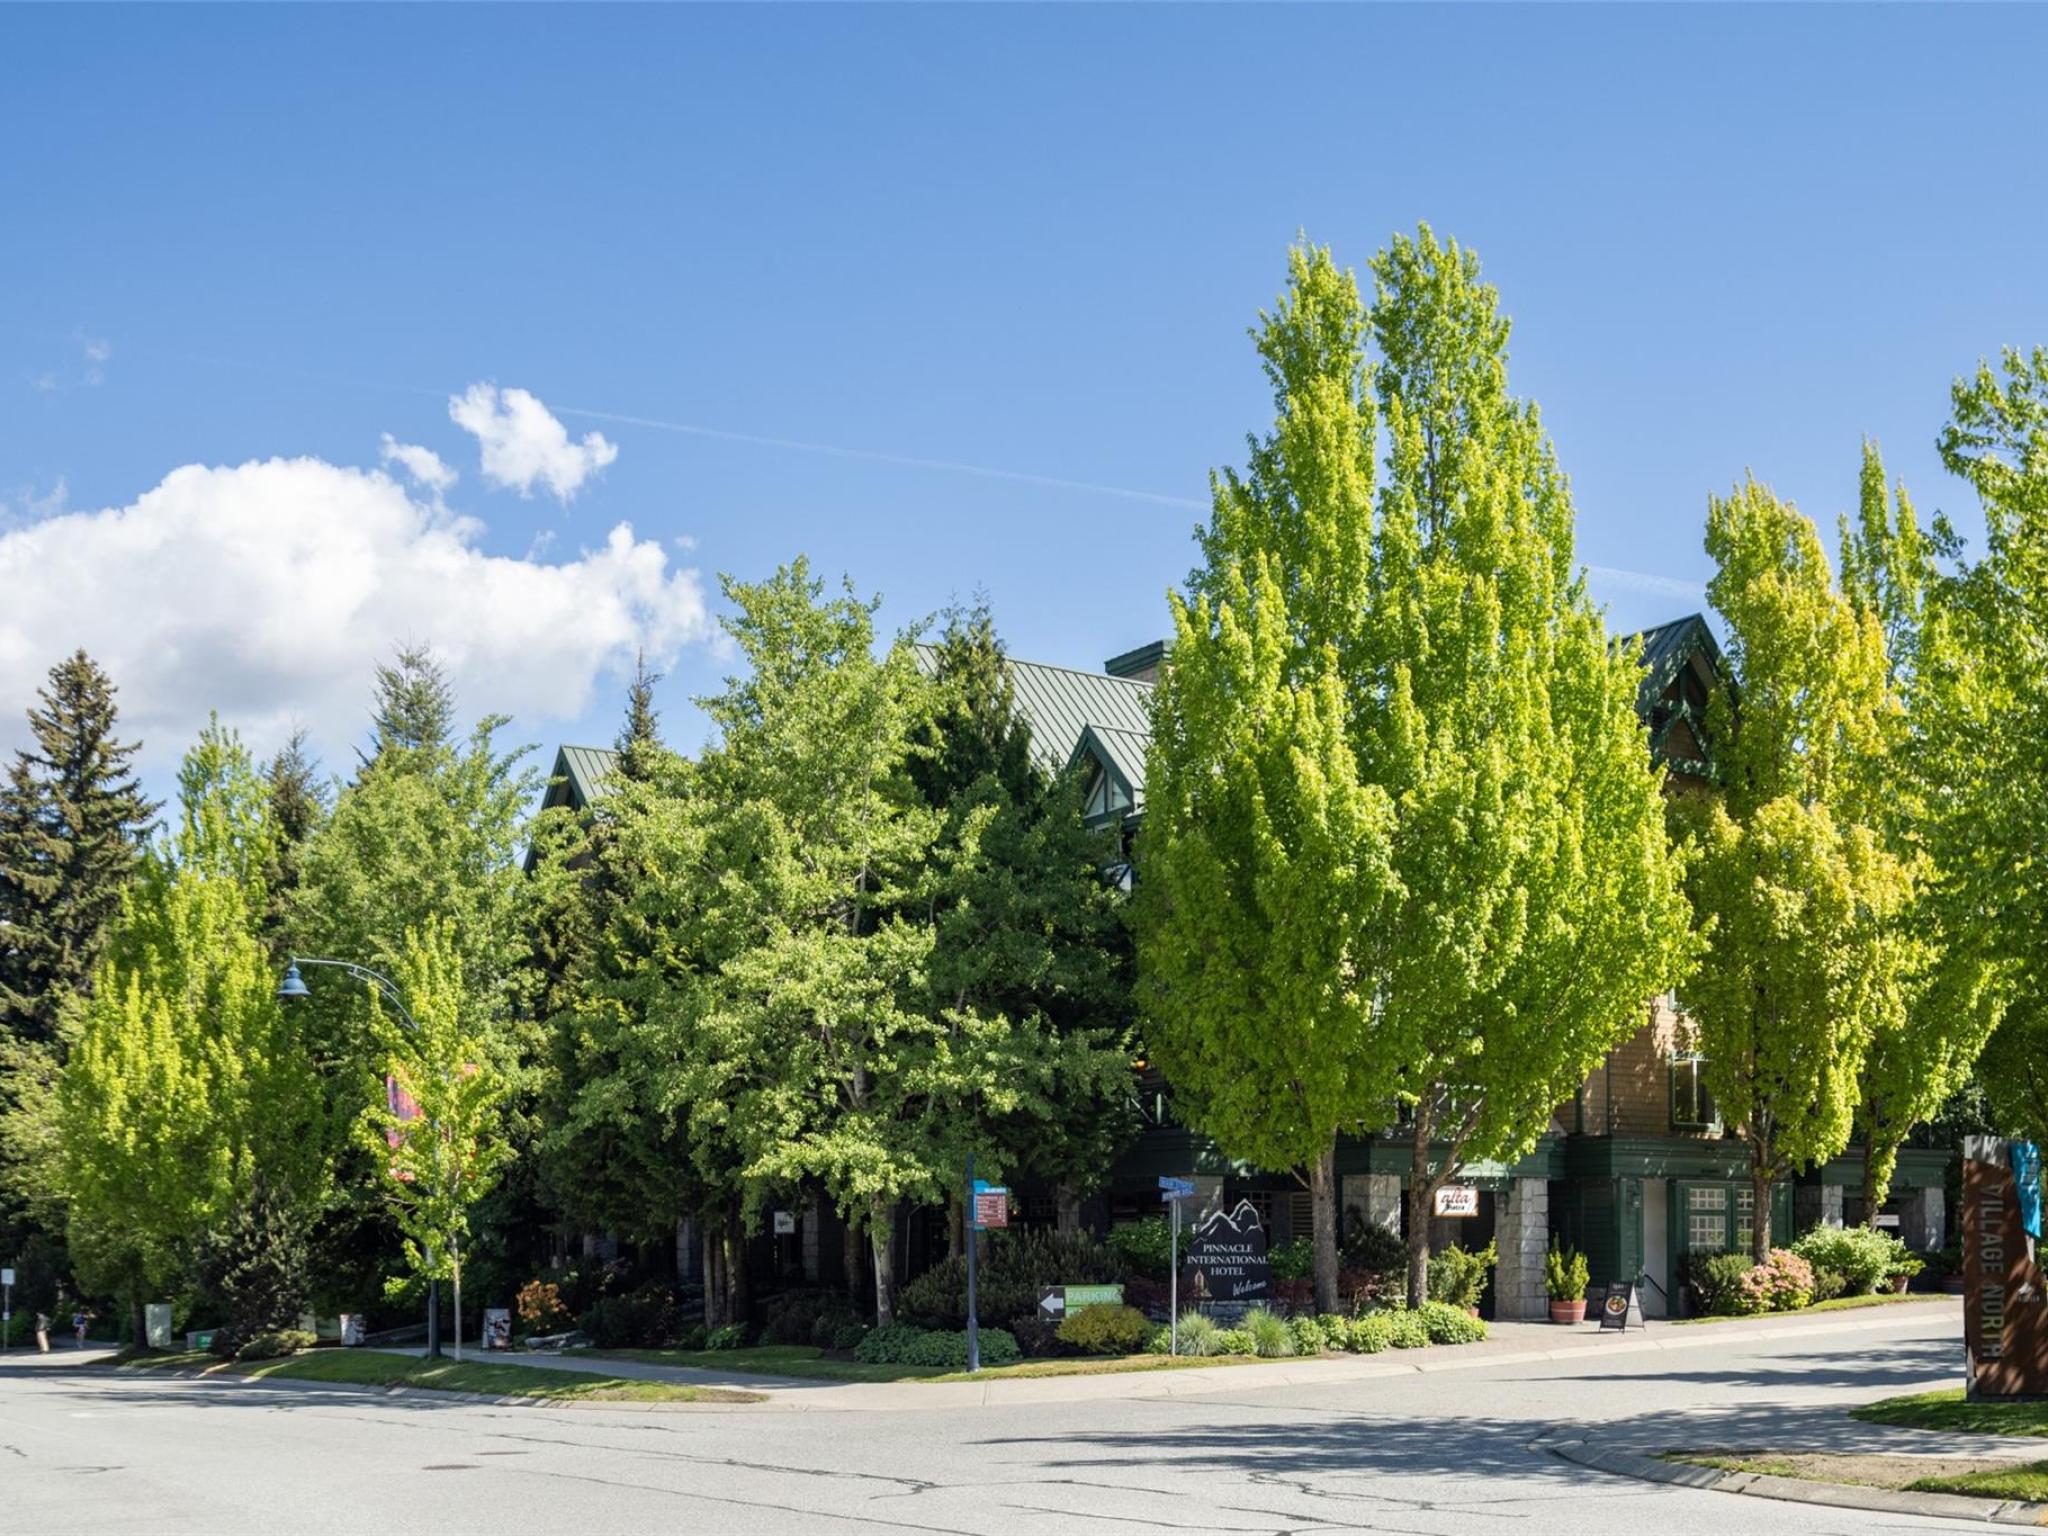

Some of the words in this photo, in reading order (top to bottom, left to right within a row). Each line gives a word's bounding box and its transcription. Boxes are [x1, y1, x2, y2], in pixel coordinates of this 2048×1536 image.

[1980, 1183, 2004, 1274] VILLAGE
[1203, 1244, 1253, 1253] PINNACLE
[1187, 1255, 1268, 1265] INTERNATIONAL
[1211, 1266, 1246, 1276] HOTEL
[1232, 1280, 1267, 1297] Welcome
[1067, 1291, 1121, 1302] PARKING
[1980, 1285, 2004, 1358] NORTH
